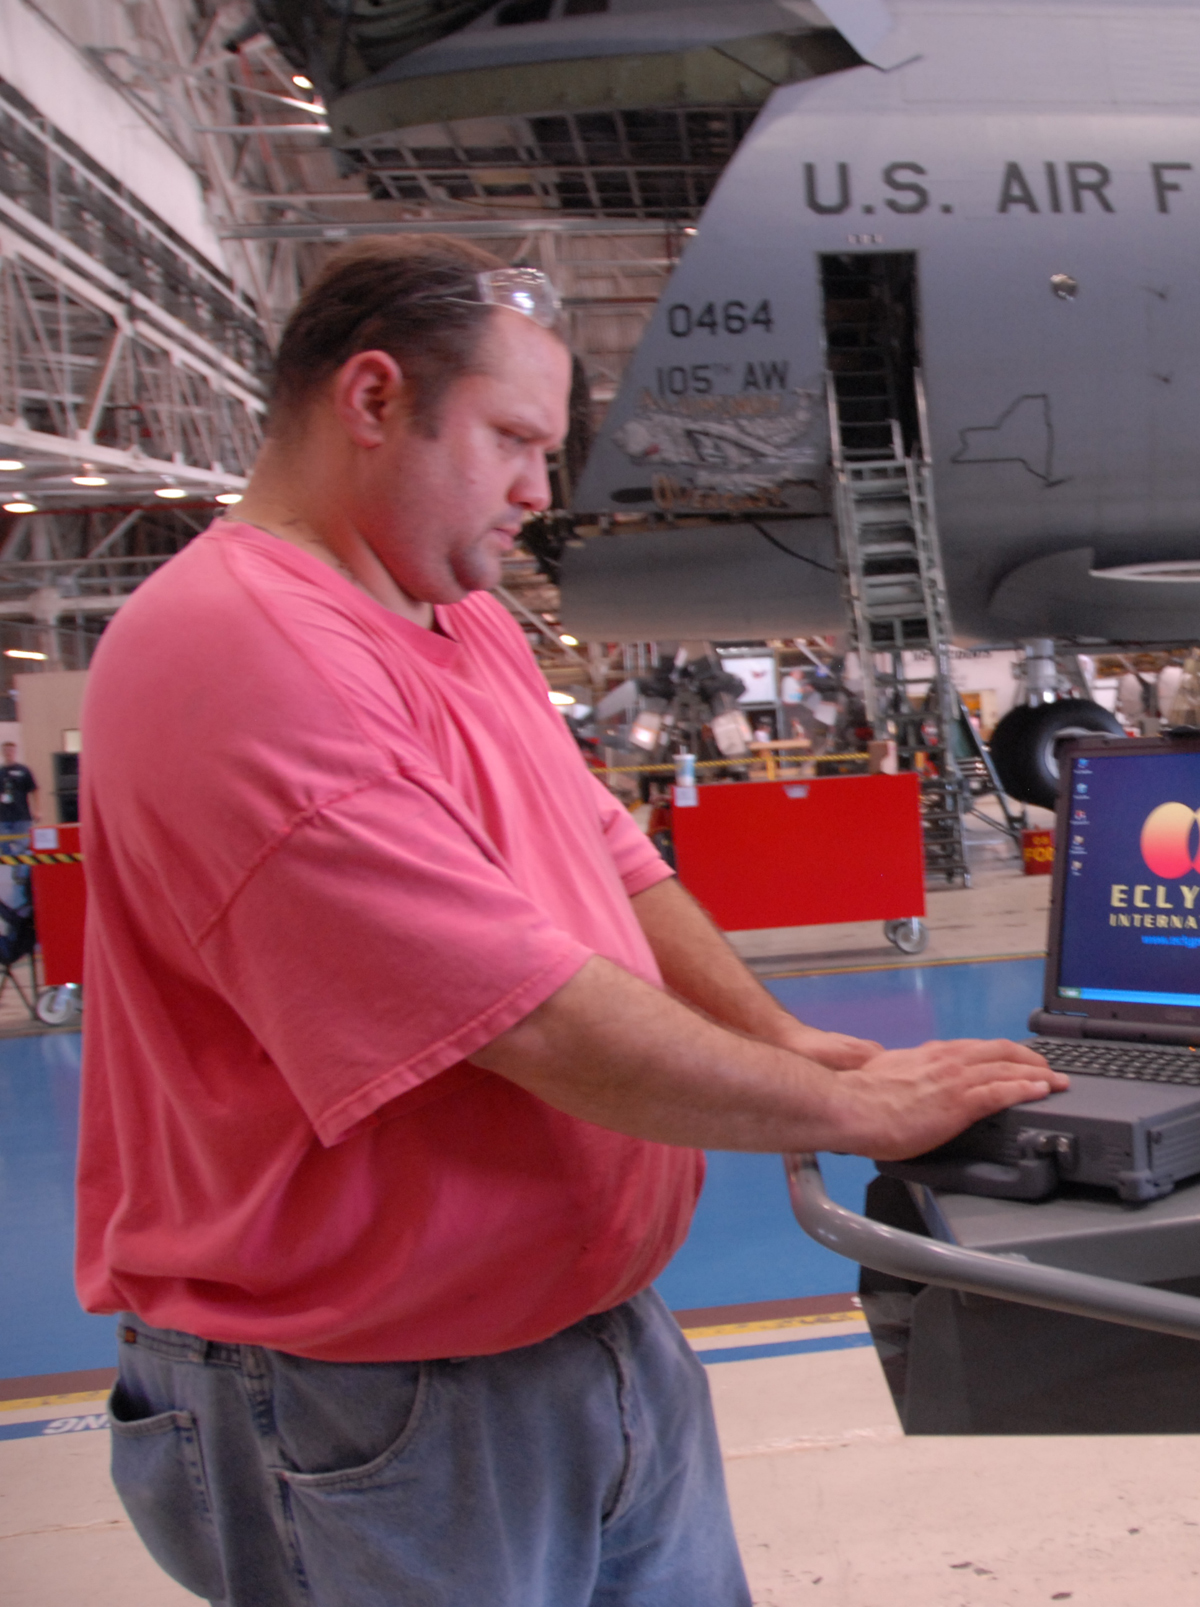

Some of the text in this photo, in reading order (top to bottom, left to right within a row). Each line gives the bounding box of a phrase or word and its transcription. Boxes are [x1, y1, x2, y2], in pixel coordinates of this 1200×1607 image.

[803, 162, 954, 215] U.S.
[997, 160, 1116, 214] AIR
[668, 299, 775, 338] 0464
[743, 360, 789, 391] AW
